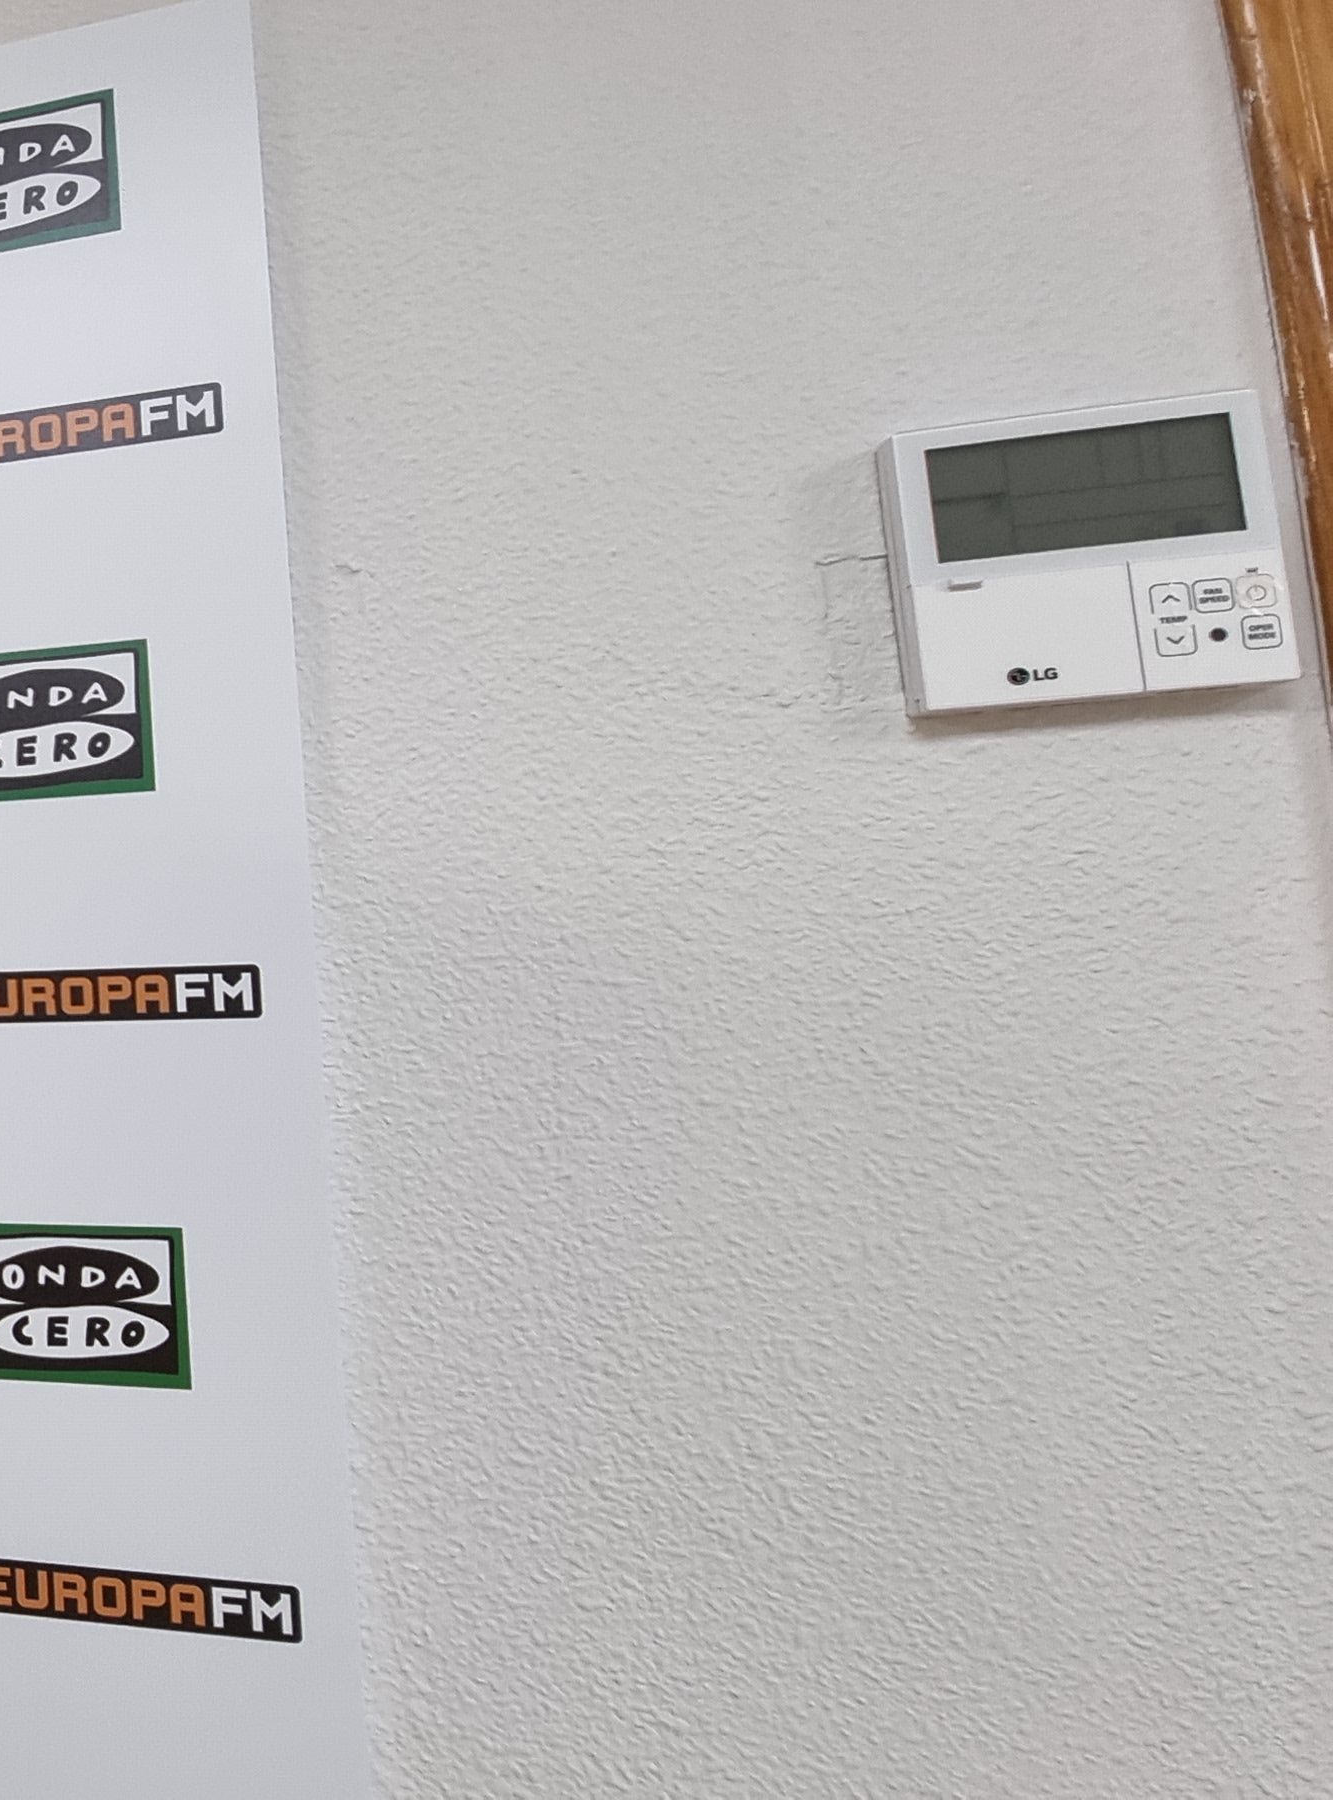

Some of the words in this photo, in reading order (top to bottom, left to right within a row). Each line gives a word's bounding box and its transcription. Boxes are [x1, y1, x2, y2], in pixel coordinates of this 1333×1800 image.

[1033, 668, 1058, 682] LG
[1, 1264, 142, 1290] ONDA
[11, 1315, 146, 1348] CERO
